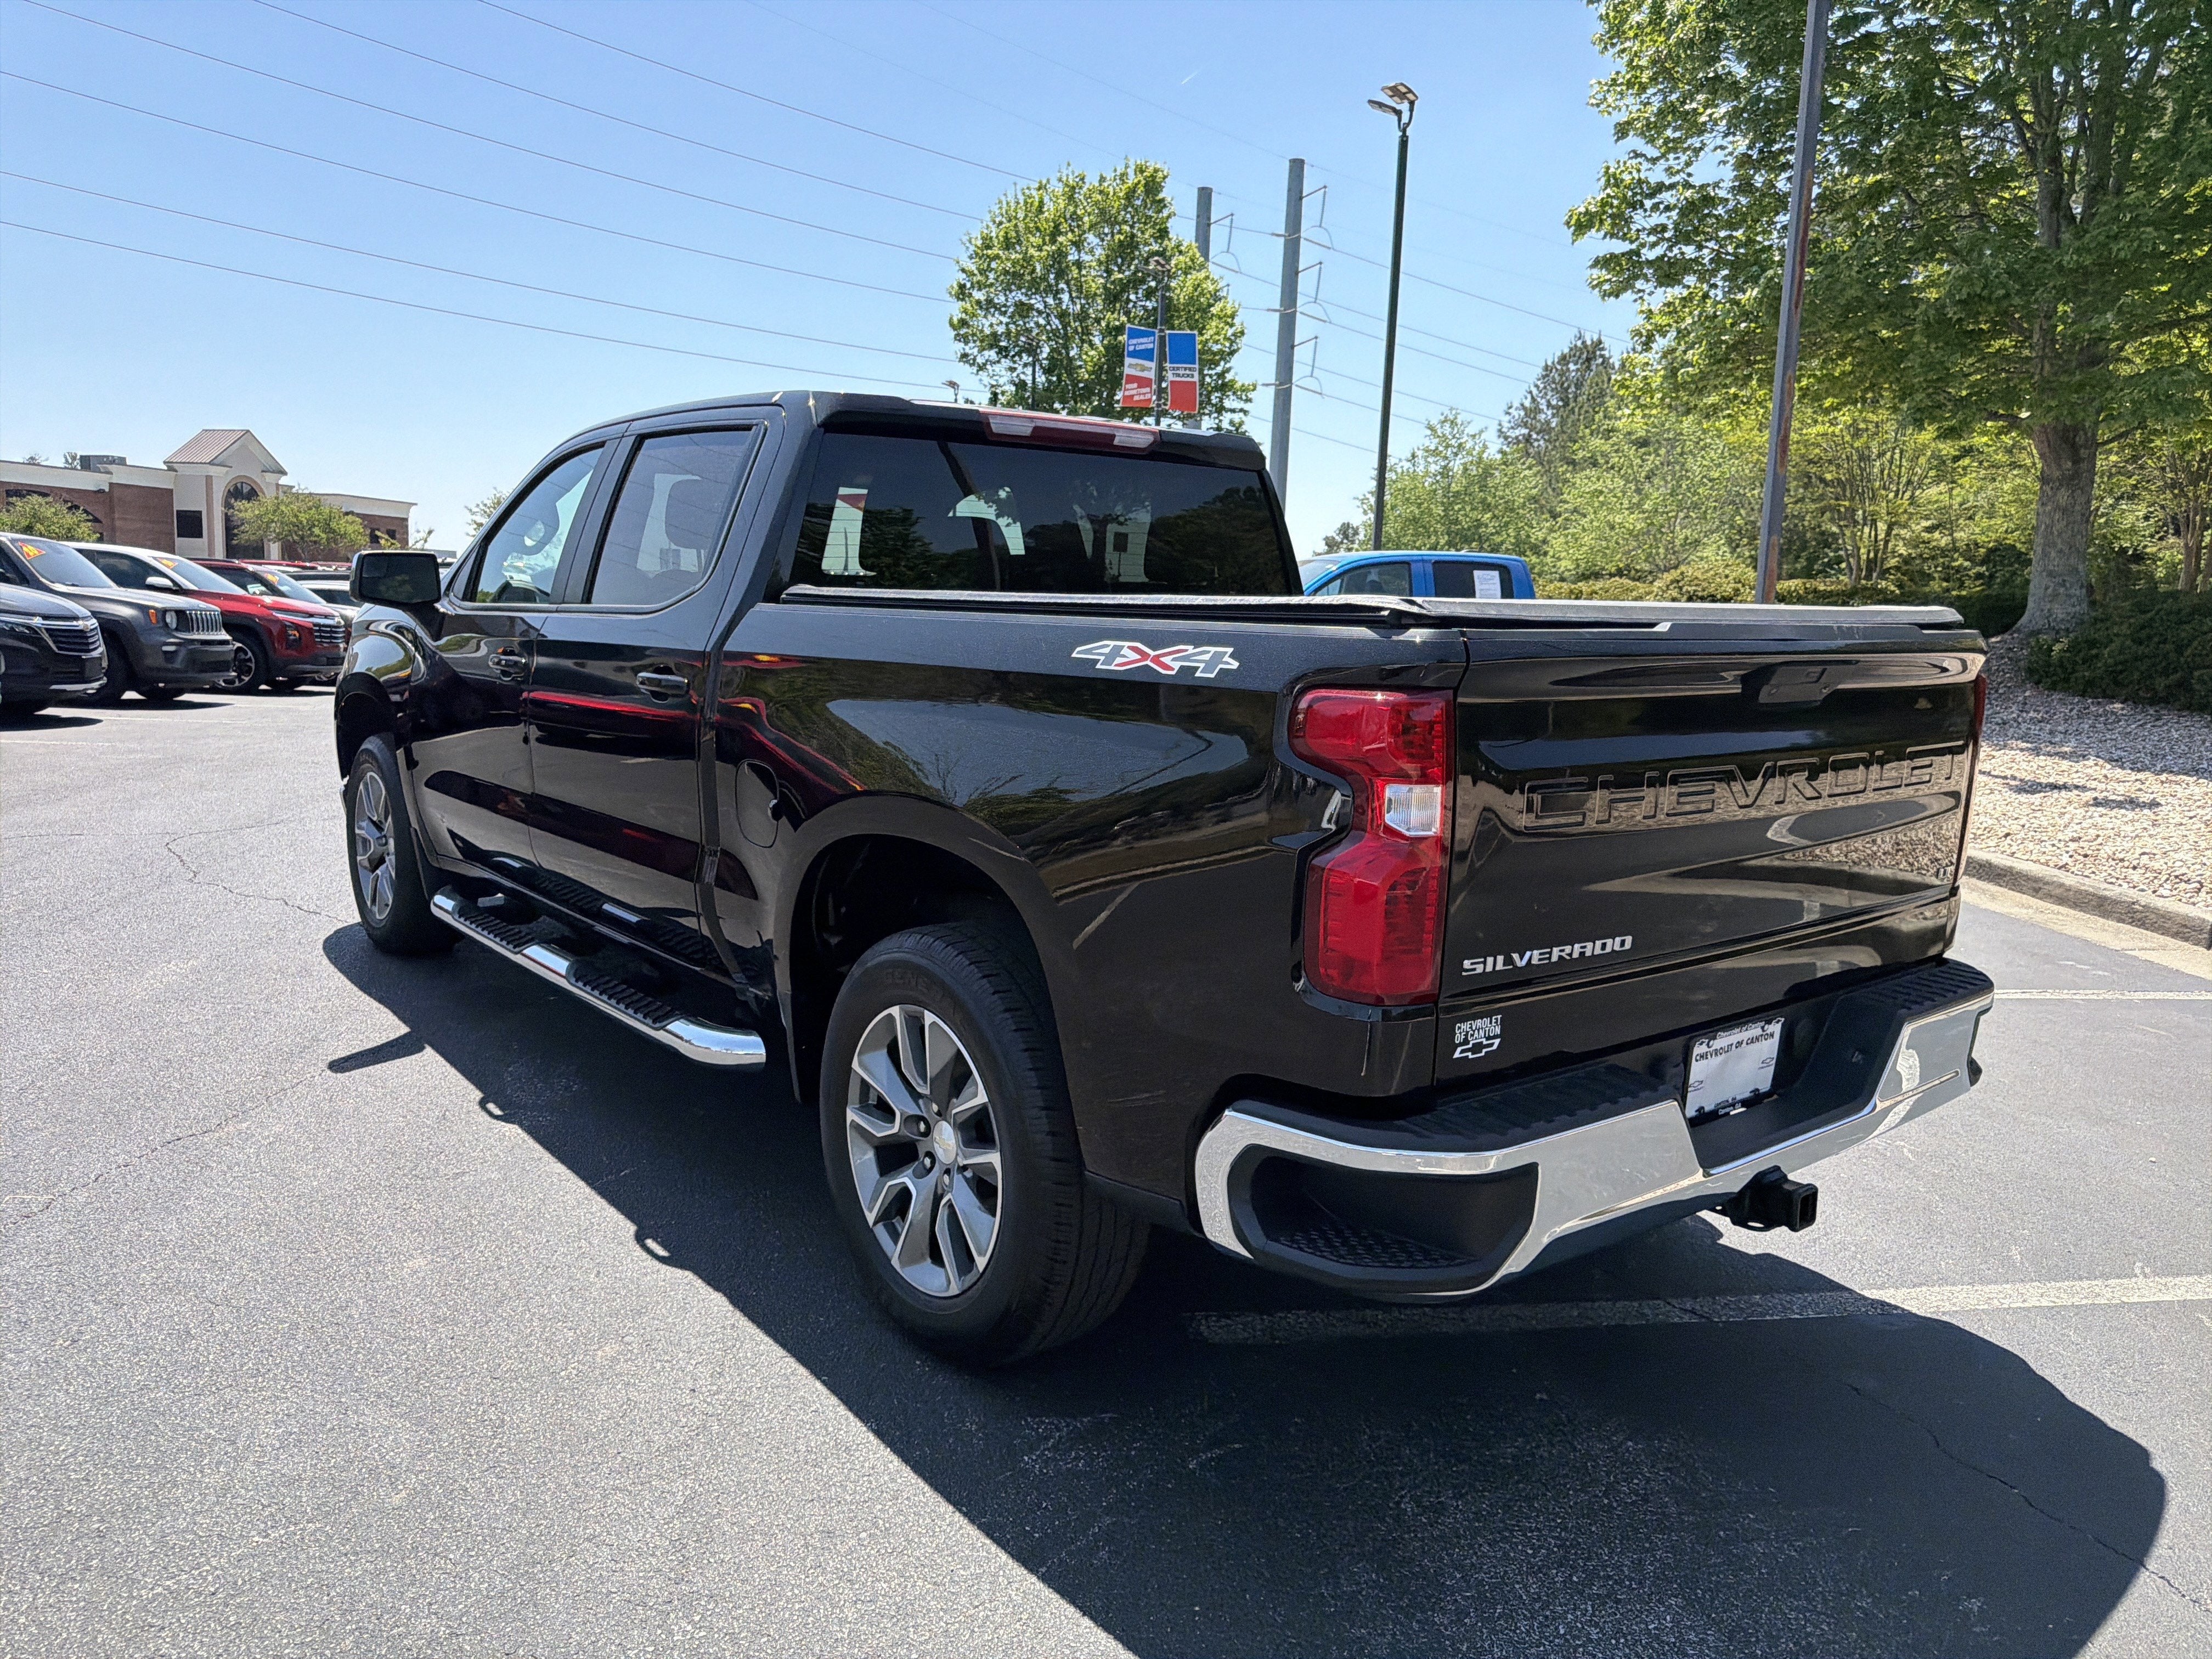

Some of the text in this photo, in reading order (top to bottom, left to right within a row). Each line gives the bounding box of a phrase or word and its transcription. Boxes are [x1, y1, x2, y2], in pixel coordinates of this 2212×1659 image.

[1523, 740, 1965, 832] CHEVROLET
[1462, 935, 1633, 975] SILVERADO
[1455, 1014, 1503, 1034] CHEVROLET
[1455, 1025, 1501, 1043] OF CANTON
[1695, 1030, 1775, 1063] CHEVROLET OF CANTON
